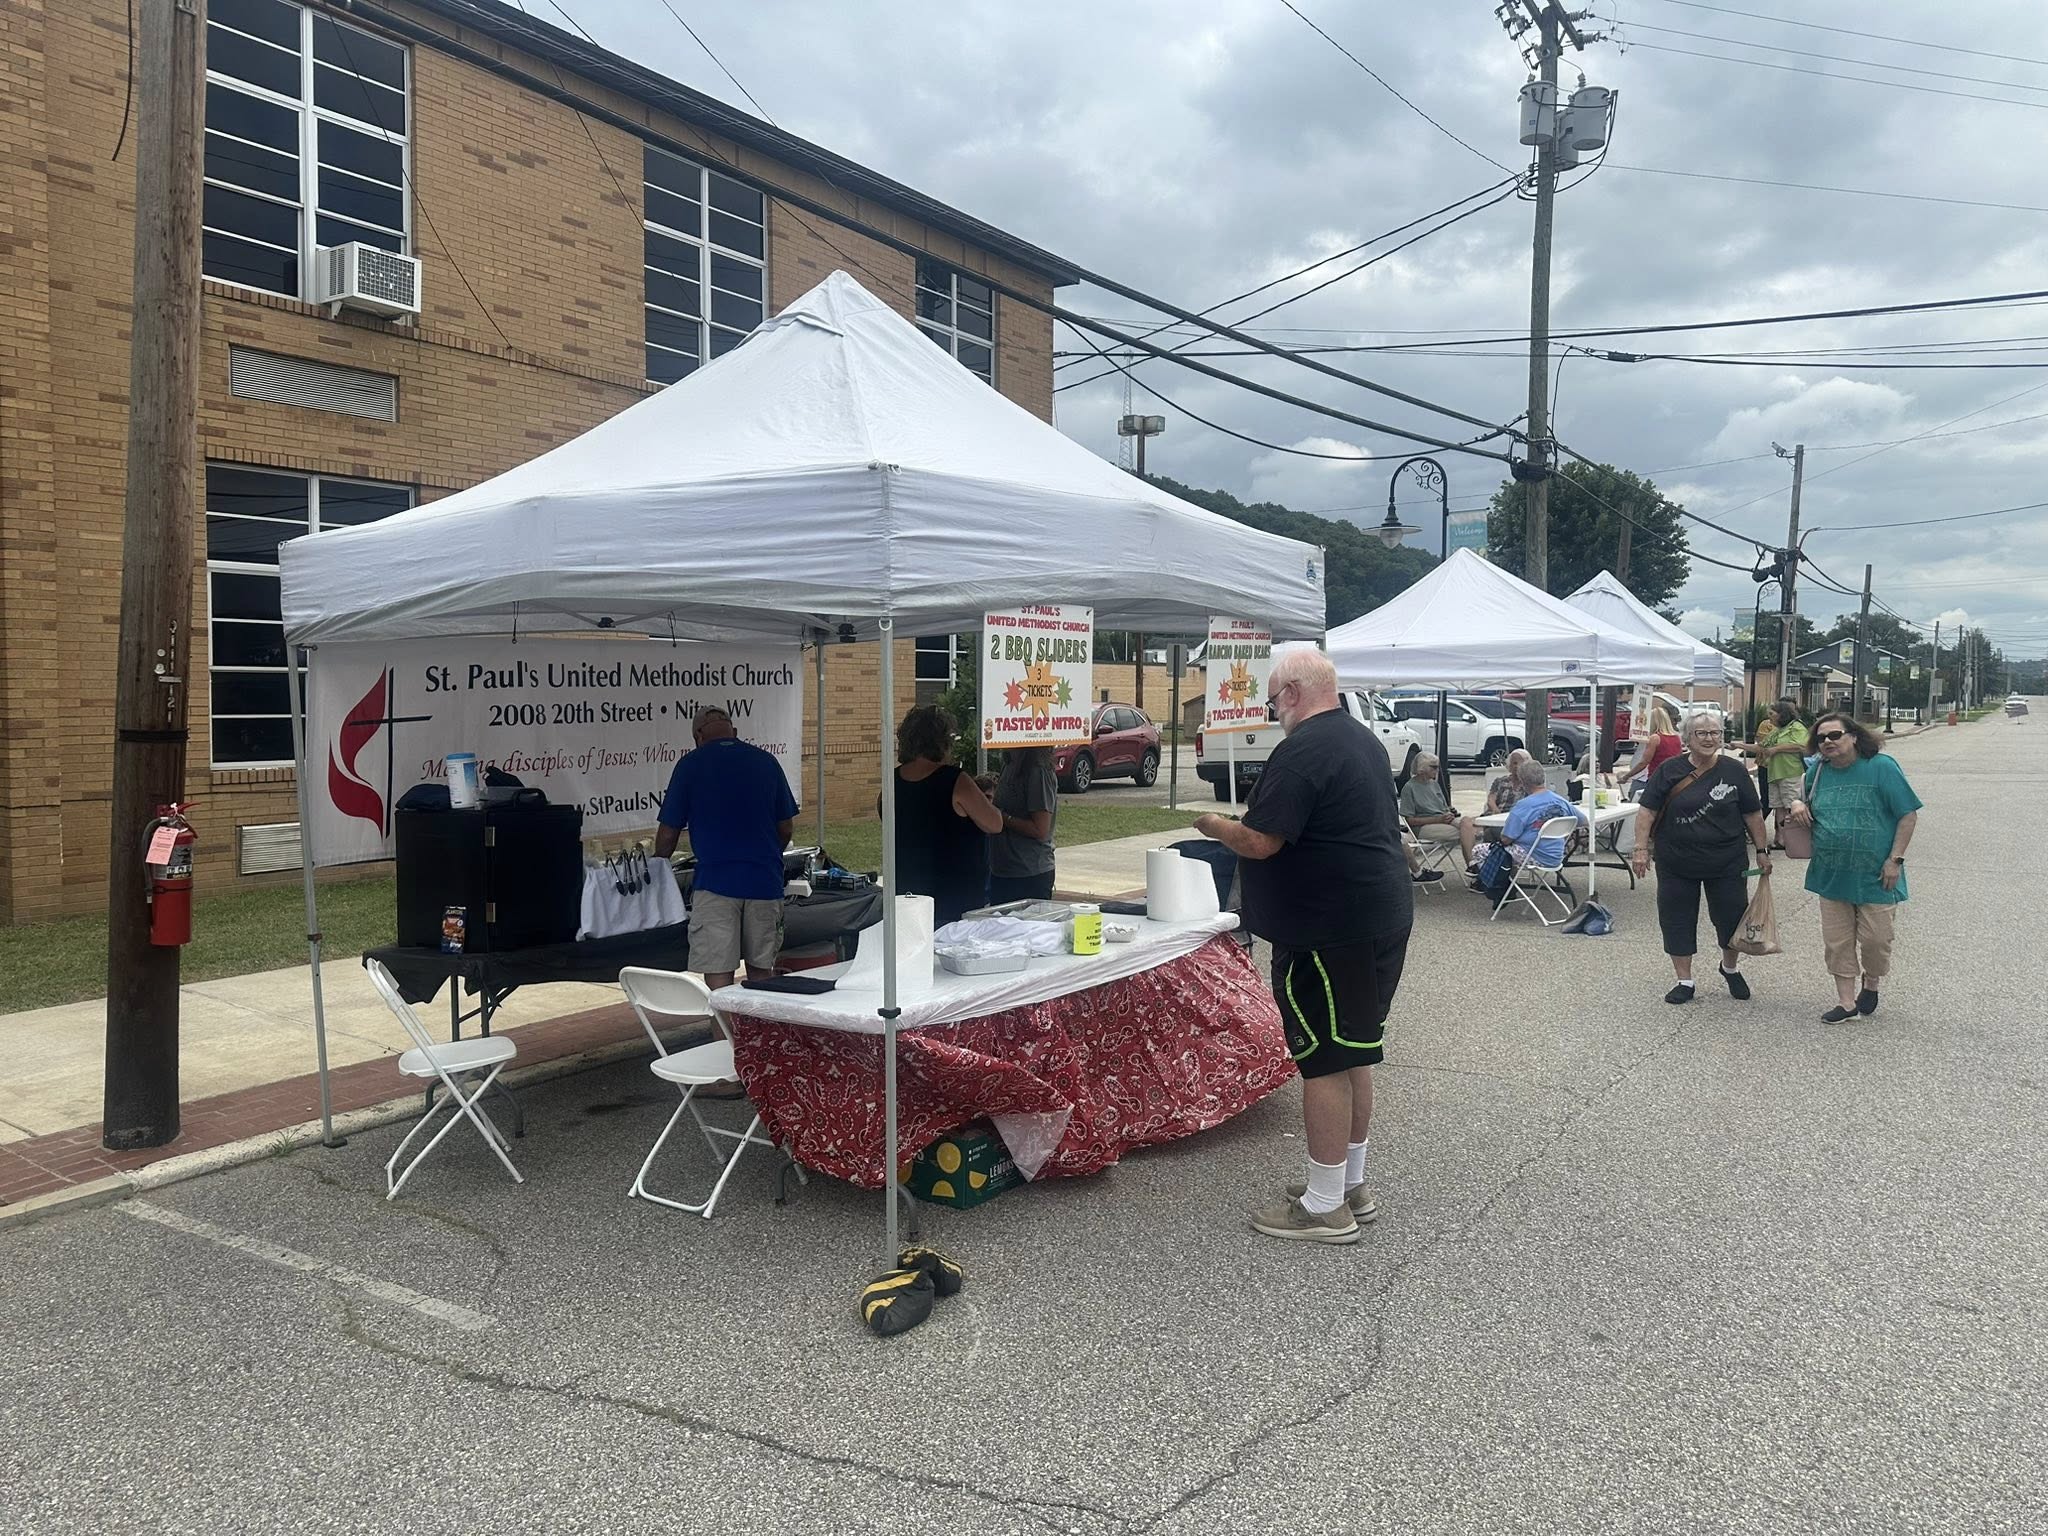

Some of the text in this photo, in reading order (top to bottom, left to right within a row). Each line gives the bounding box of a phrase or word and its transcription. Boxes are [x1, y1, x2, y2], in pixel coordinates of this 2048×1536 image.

[1021, 605, 1060, 616] ST. PAUL'S
[987, 615, 1090, 632] UNITED METHODIST CHURCH
[1211, 631, 1271, 640] UNITED METHODIST CHURCH
[991, 634, 1087, 666] 2 BBQ SLIDERS
[1233, 644, 1253, 660] BAKED
[425, 660, 794, 693] St. Paul's United Methodist Church
[1037, 668, 1042, 681] 3
[1027, 684, 1053, 697] TICKETS
[1232, 680, 1247, 691] TICKETS
[488, 703, 547, 727] 2008
[551, 700, 594, 724] 20th
[600, 701, 653, 723] Street
[727, 699, 754, 719] WV
[1212, 706, 1264, 721] TASTE OF NITRO
[994, 716, 1082, 732] TASTE OF NITRO
[502, 748, 574, 777] disciples
[577, 746, 596, 775] of
[596, 748, 638, 771] Jesus;
[644, 743, 676, 764] Who
